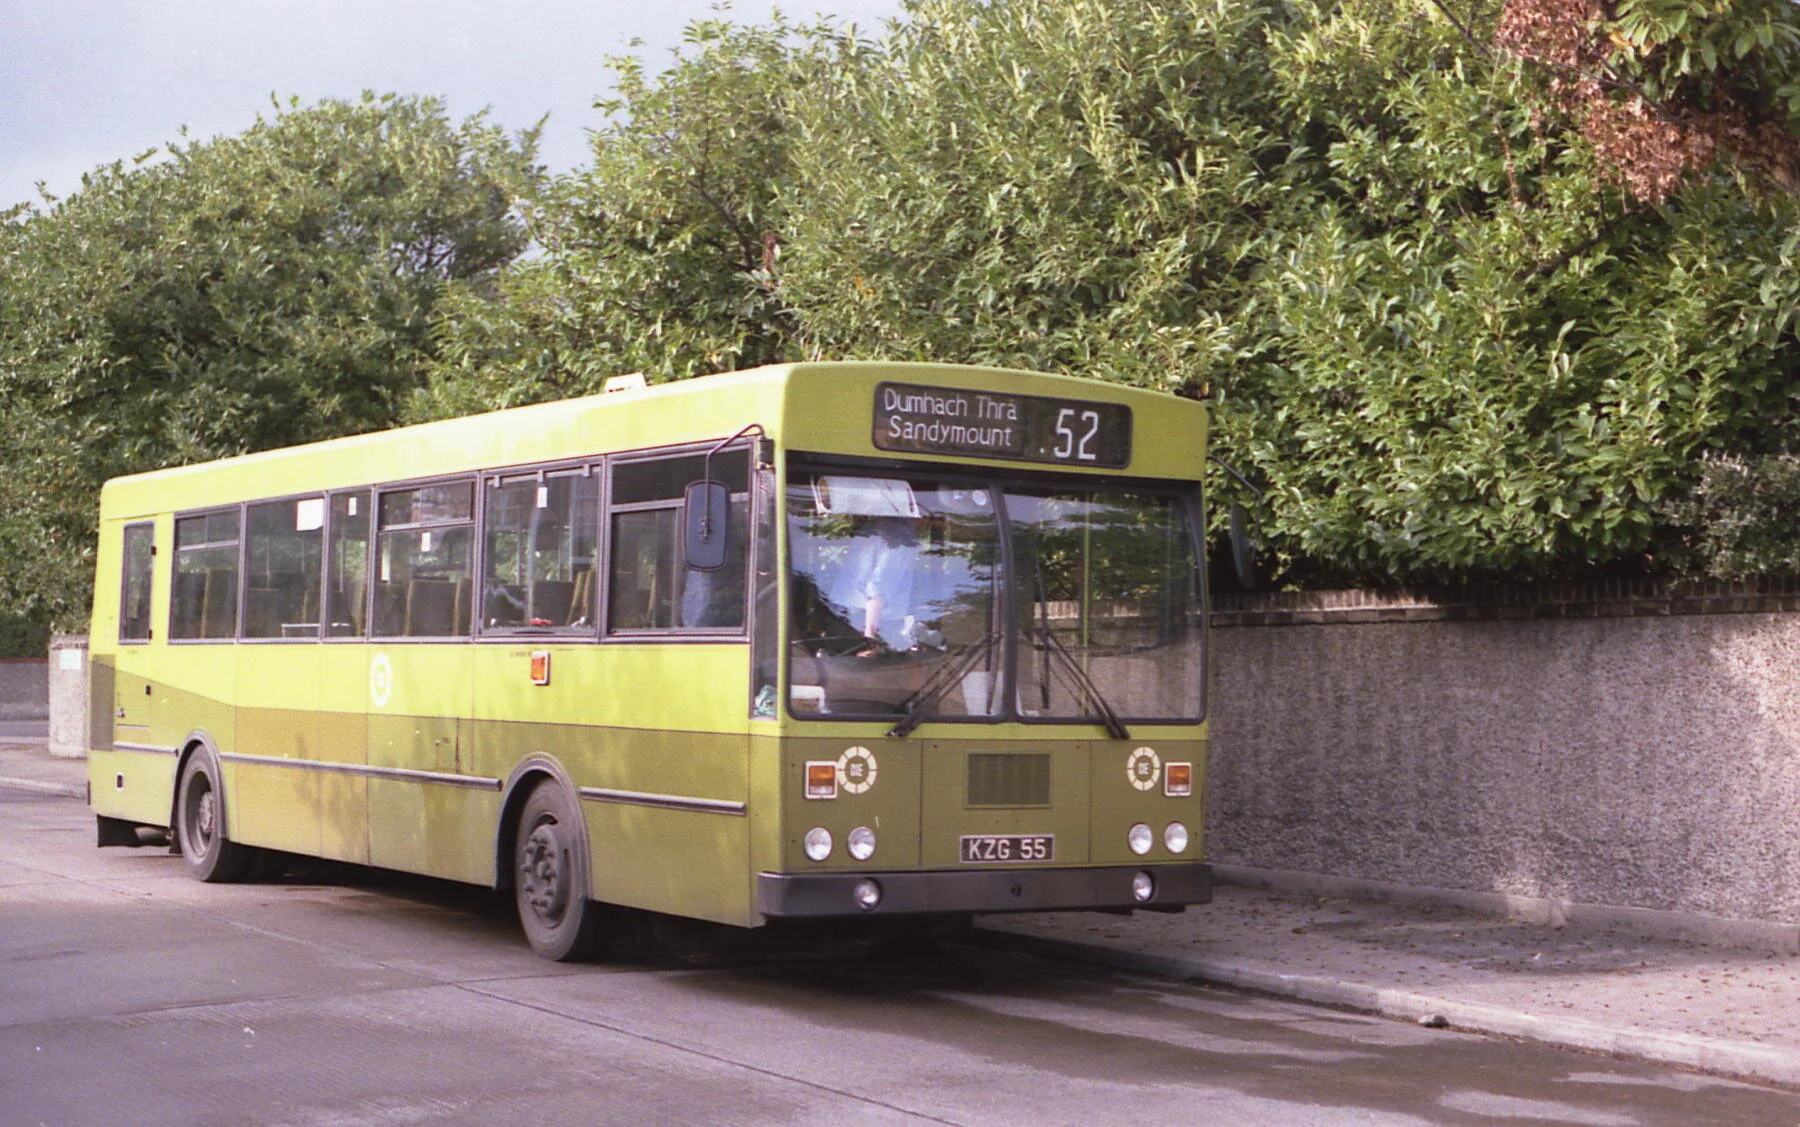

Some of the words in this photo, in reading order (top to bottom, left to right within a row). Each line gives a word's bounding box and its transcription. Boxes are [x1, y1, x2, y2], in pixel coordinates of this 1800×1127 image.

[888, 415, 1012, 446] Sandymount
[1054, 408, 1098, 460] 52
[969, 839, 1010, 860] KZG
[1020, 839, 1046, 859] 55
